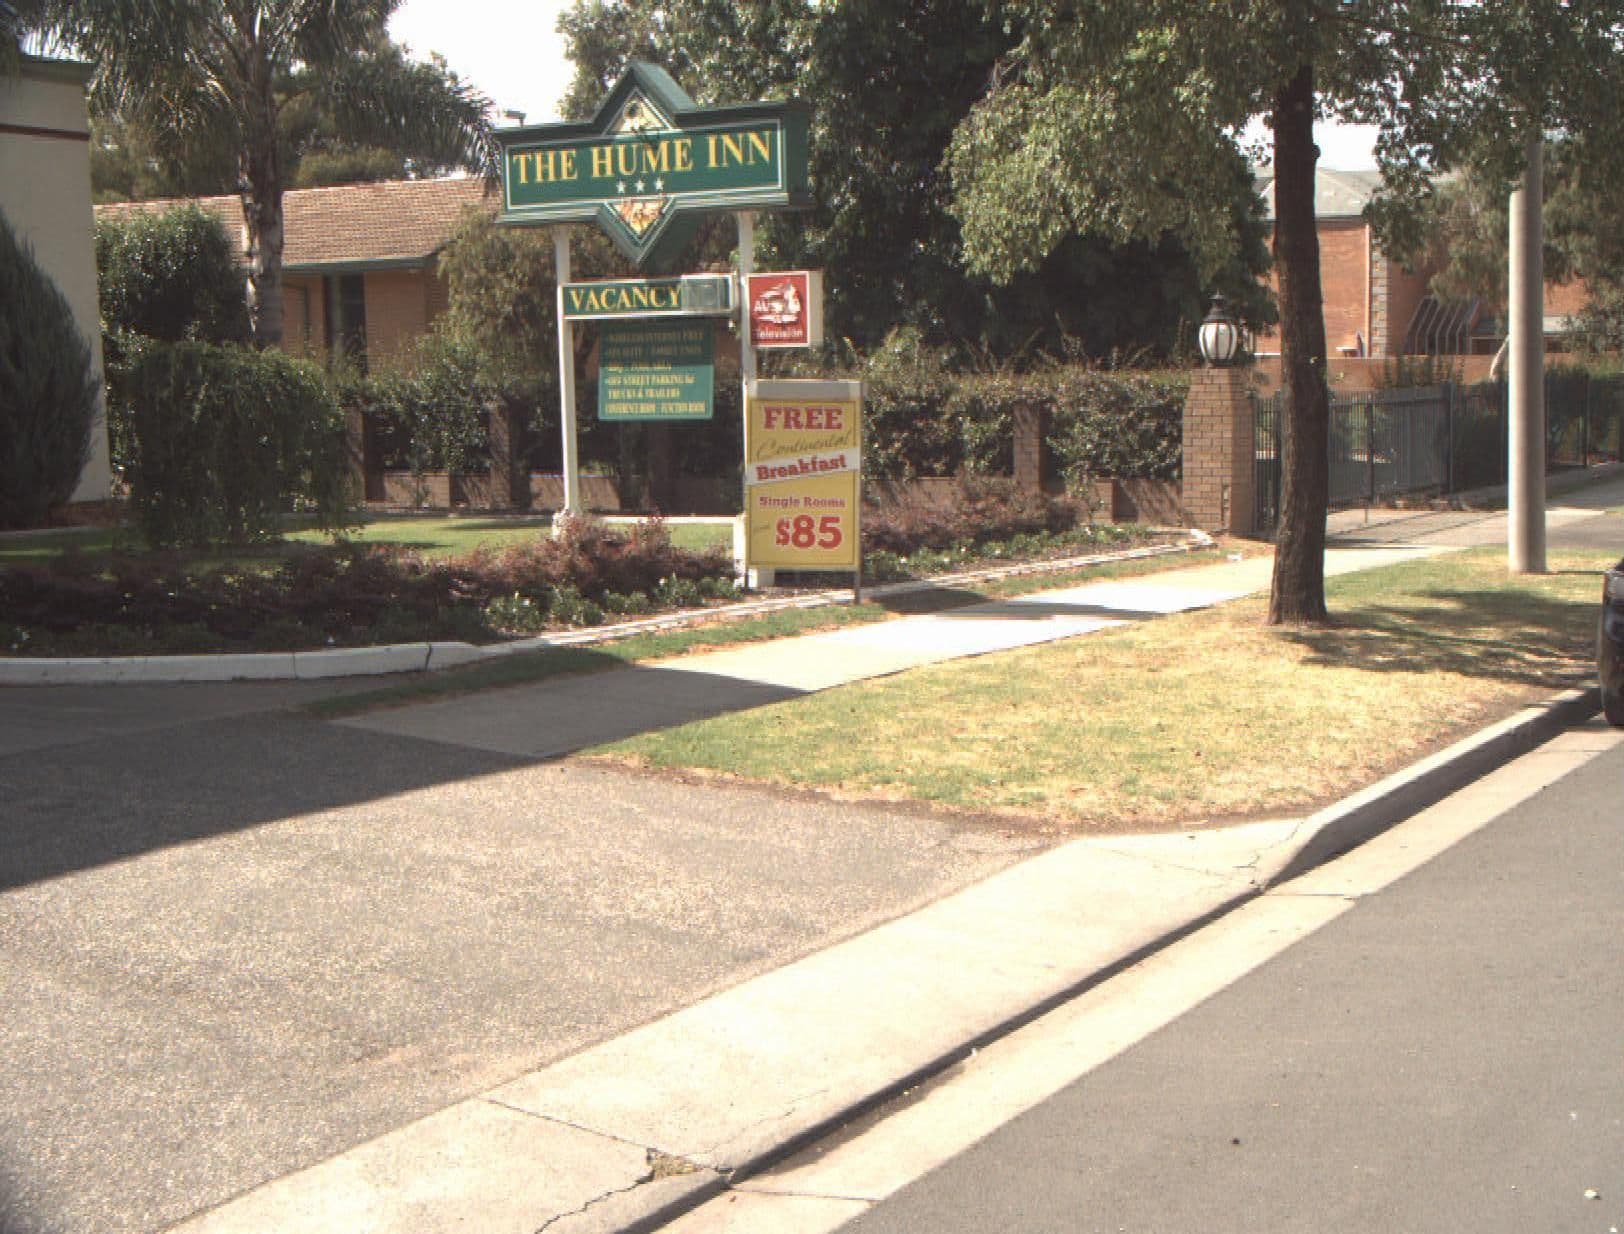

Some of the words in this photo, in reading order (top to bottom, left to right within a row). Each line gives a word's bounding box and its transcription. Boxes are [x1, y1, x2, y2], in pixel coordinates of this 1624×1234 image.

[513, 150, 578, 184] THE
[592, 138, 693, 178] HUME
[707, 130, 772, 168] INN
[568, 286, 681, 312] VACANCY
[764, 406, 842, 430] FREE
[756, 428, 852, 461] Continental
[755, 455, 847, 480] Breakfast
[760, 496, 801, 509] Single
[803, 496, 846, 509] Rooms
[776, 514, 843, 550] $85
